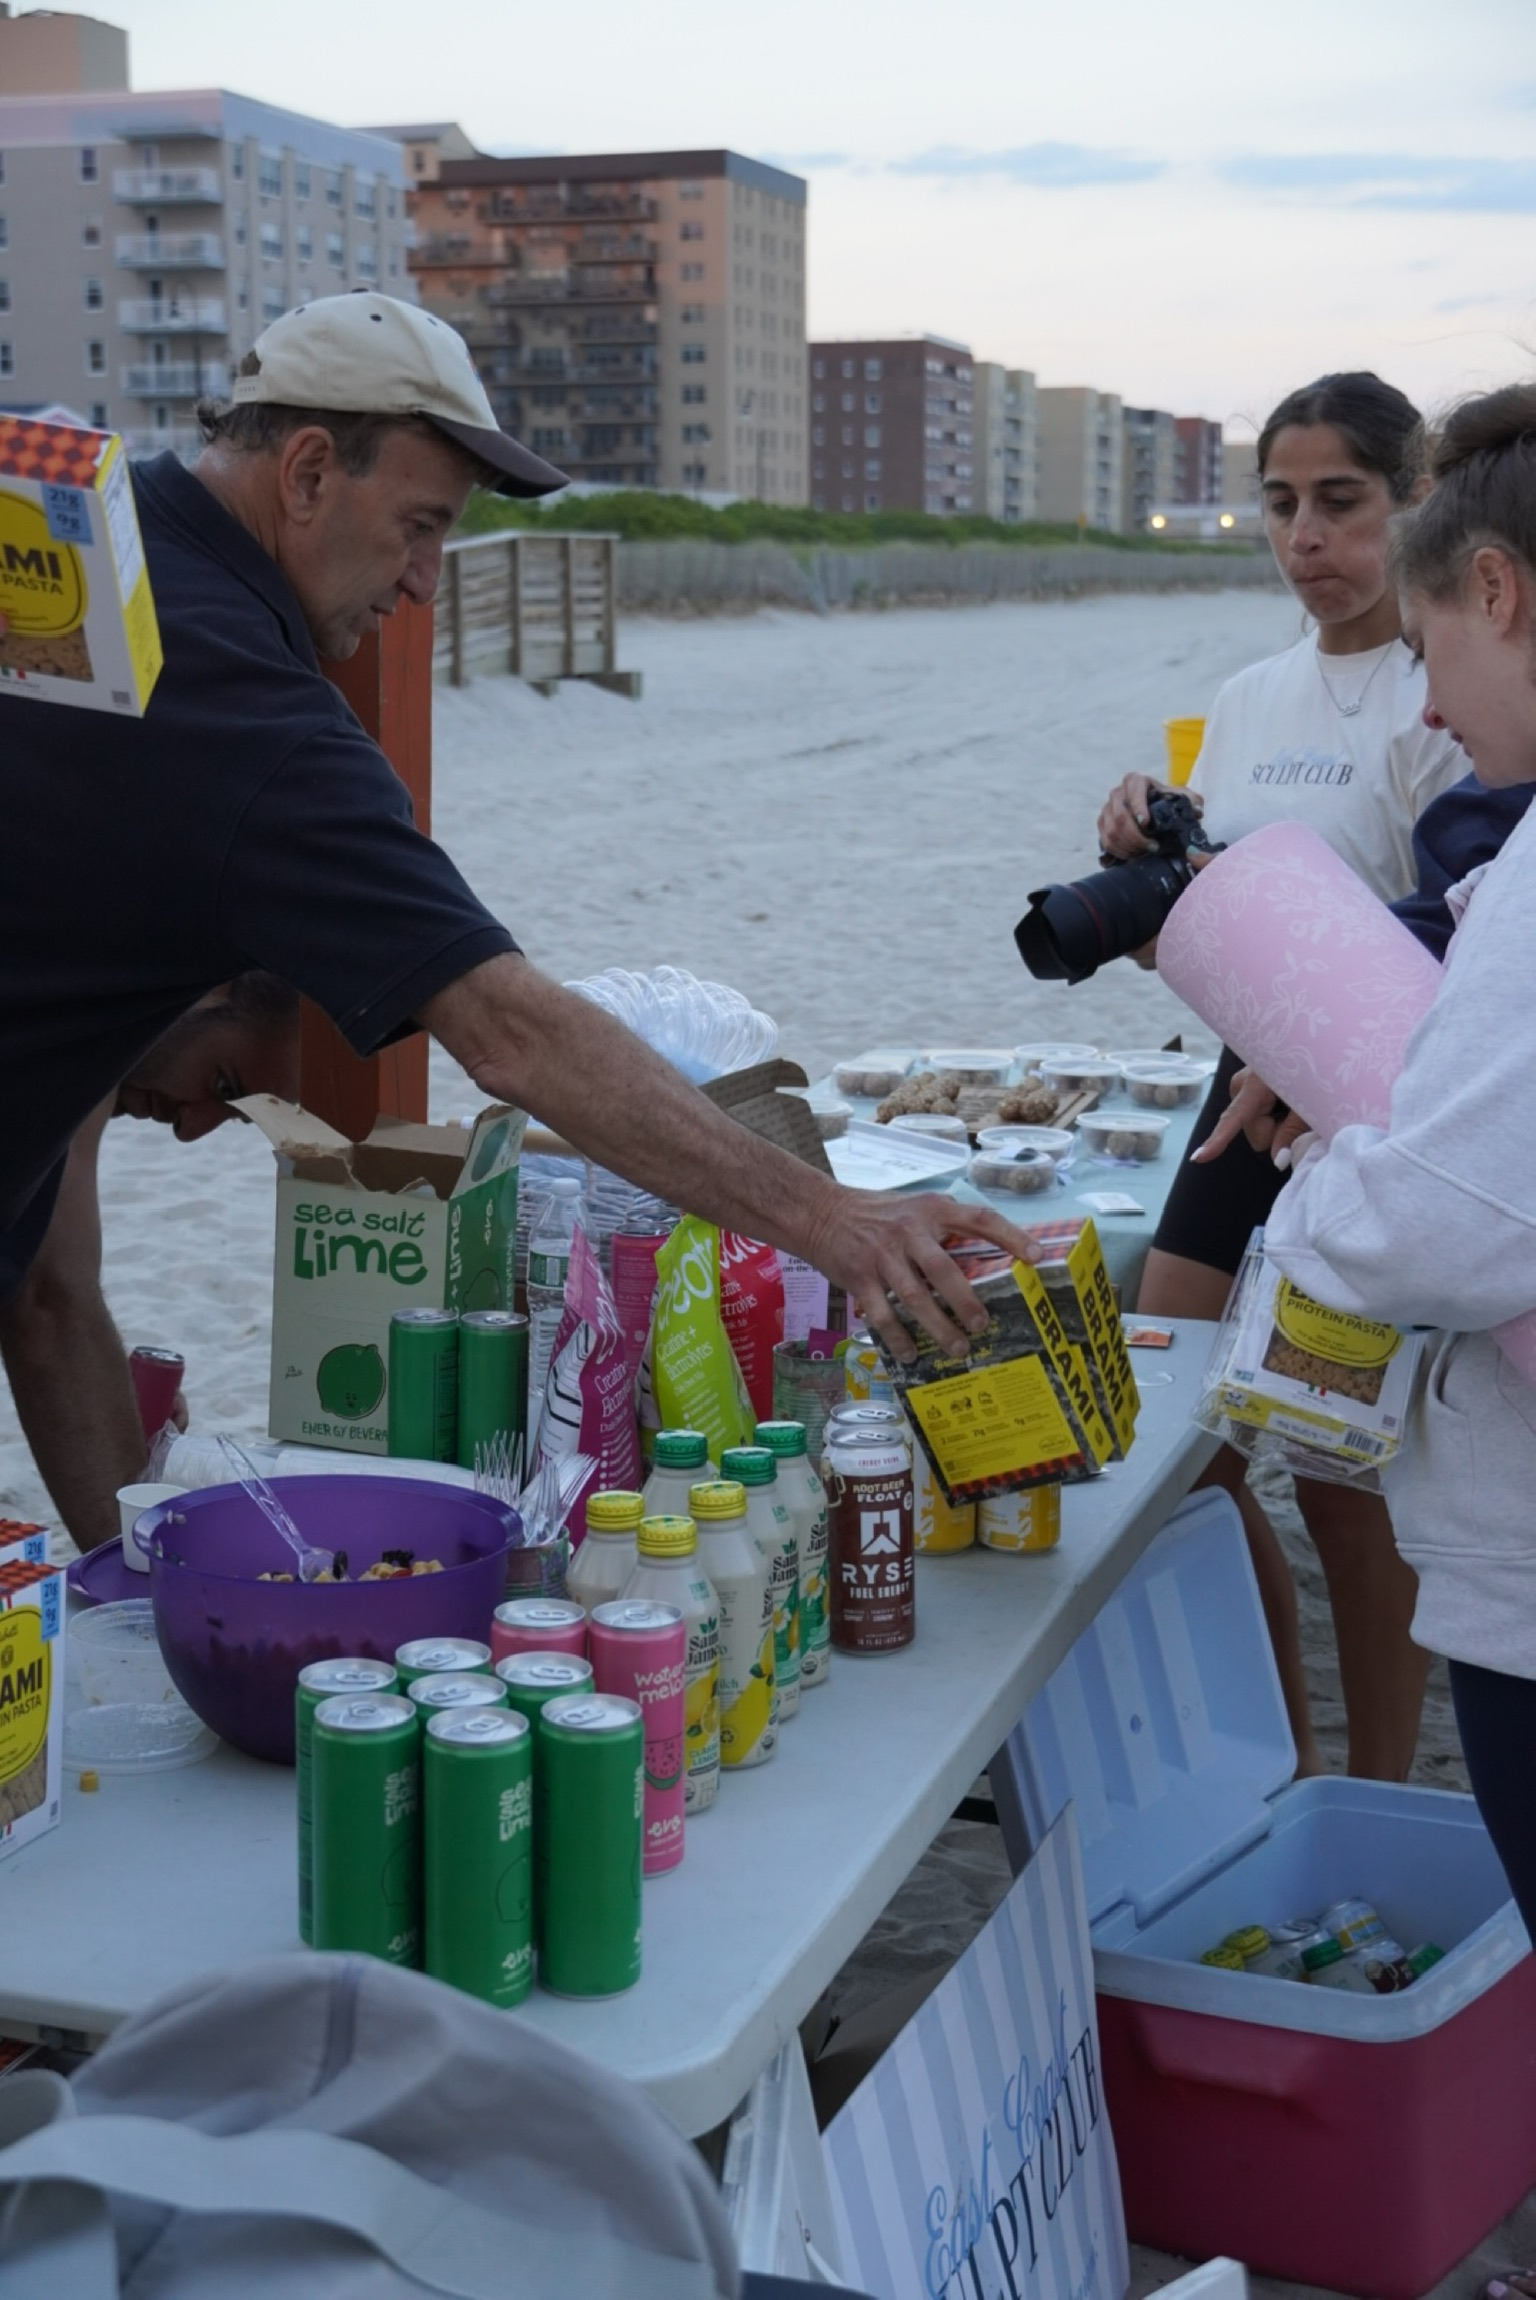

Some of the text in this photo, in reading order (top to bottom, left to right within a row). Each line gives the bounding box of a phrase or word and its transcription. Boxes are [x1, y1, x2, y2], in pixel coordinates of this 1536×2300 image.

[0, 543, 62, 581] MI
[2, 572, 64, 596] PASTA
[1304, 763, 1353, 786] CLUB
[293, 1203, 426, 1239] sea salt
[293, 1226, 429, 1286] Lime
[1092, 1258, 1131, 1386] BRAMI
[1286, 1298, 1386, 1340] PROTEIN PASTA
[1034, 1294, 1096, 1425] BRAMI
[1083, 1287, 1124, 1415] BRAMI
[301, 1421, 389, 1442] ENERGY BEVERA
[857, 1458, 881, 1468] ENERGY
[852, 1479, 905, 1495] ROOT BEER
[857, 1490, 902, 1503] FLOAT
[841, 1556, 914, 1585] RYSE
[850, 1580, 910, 1599] FUEL ENERGY
[0, 1657, 43, 1710] AMI
[634, 1661, 686, 1688] Water
[638, 1674, 686, 1705] melo
[13, 1693, 42, 1719] PASTA
[1040, 2025, 1100, 2220] CLUB
[925, 1987, 1069, 2300] East Coast
